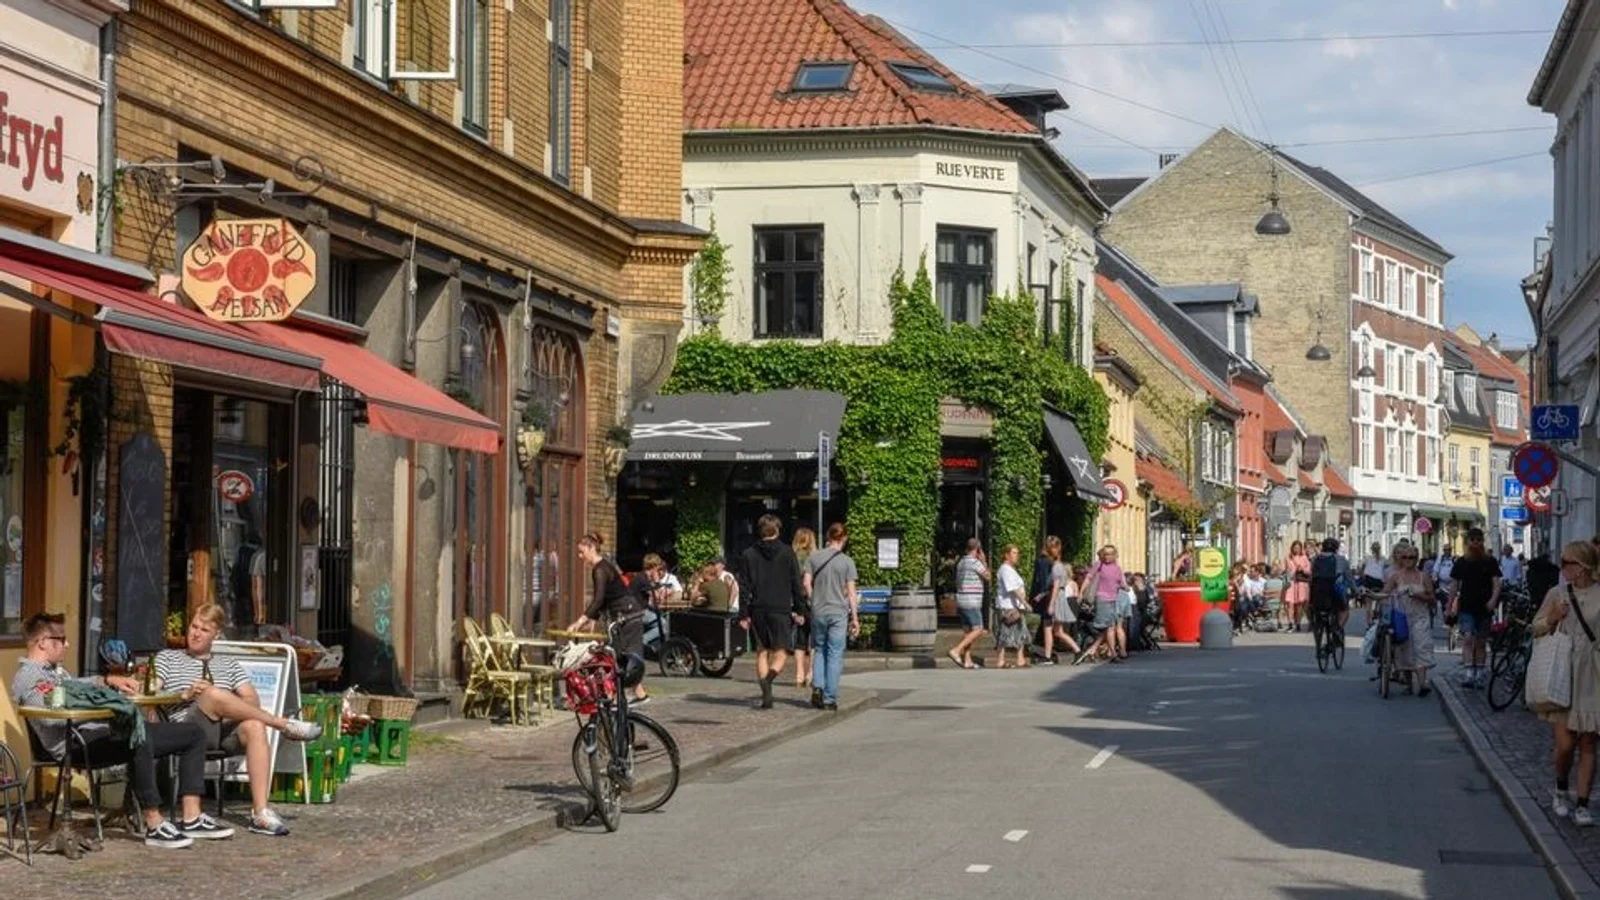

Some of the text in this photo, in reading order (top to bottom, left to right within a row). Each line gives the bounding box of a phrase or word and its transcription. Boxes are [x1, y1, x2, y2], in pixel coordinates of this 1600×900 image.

[936, 161, 1005, 181] RUE VERTE
[191, 223, 306, 267] GANEFRYD
[211, 291, 291, 318] HELSAM
